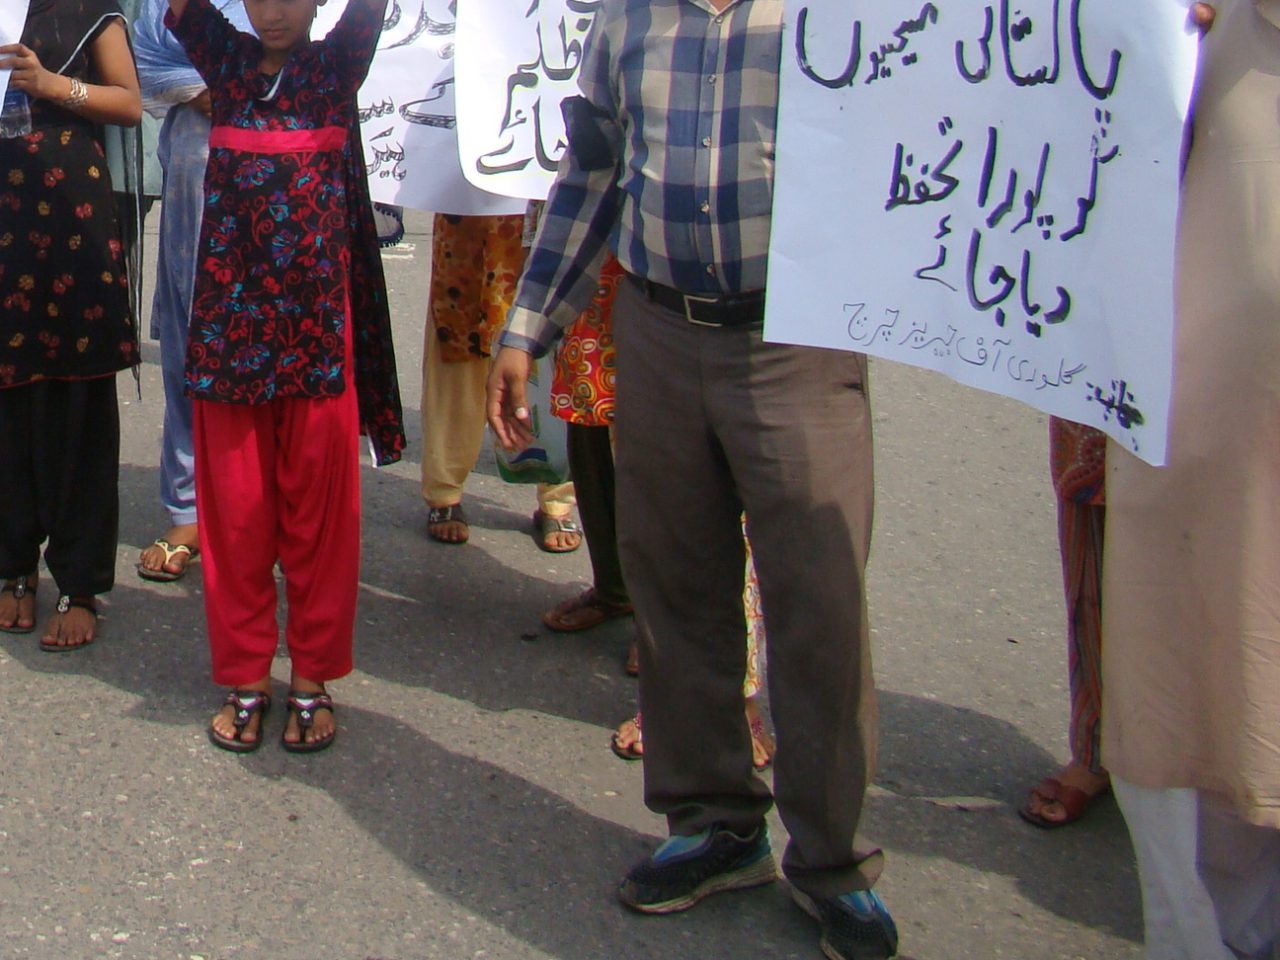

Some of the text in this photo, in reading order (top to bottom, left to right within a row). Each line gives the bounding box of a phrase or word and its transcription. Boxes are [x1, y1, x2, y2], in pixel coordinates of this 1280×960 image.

[885, 116, 963, 212] تحفظ
[978, 126, 1053, 240] پورا
[914, 214, 1071, 338] دیا جائے
[956, 336, 1012, 372] آف
